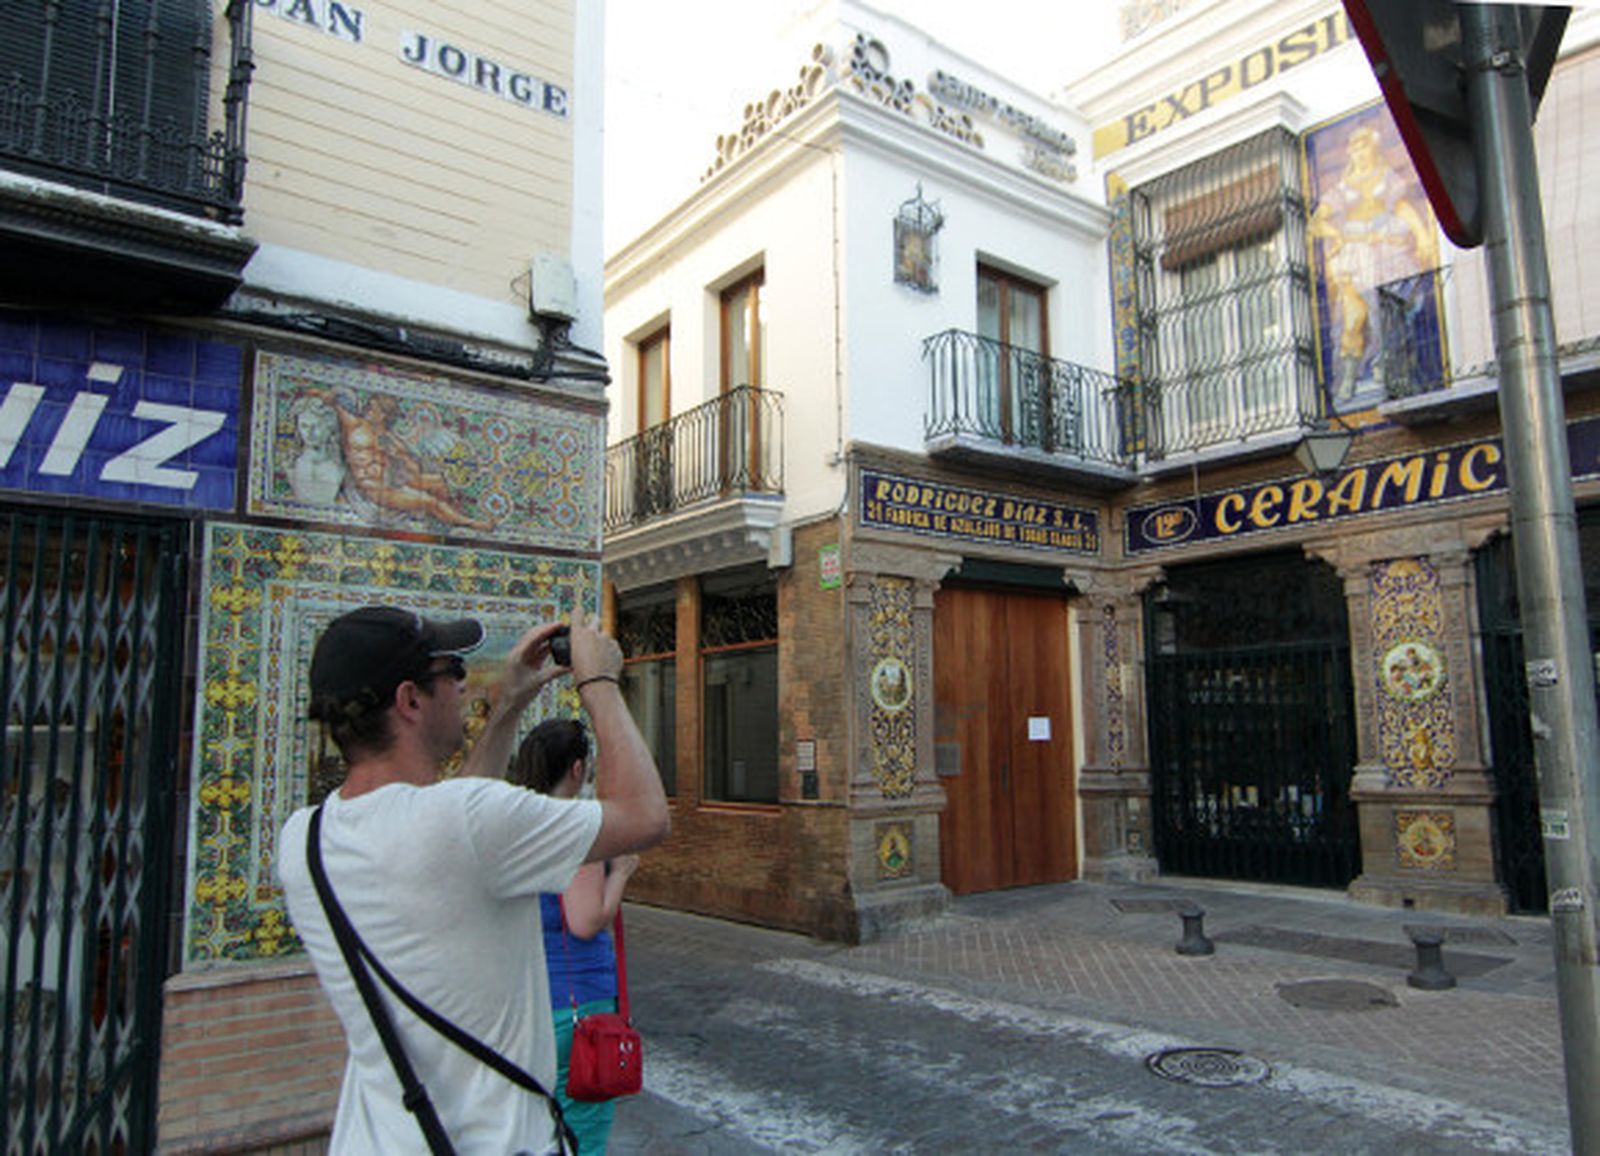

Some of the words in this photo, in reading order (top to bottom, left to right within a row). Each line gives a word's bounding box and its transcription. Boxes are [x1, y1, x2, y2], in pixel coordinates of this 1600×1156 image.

[255, 0, 362, 42] AN
[403, 34, 567, 117] JORGE
[876, 479, 997, 515] RODRIGUEZ
